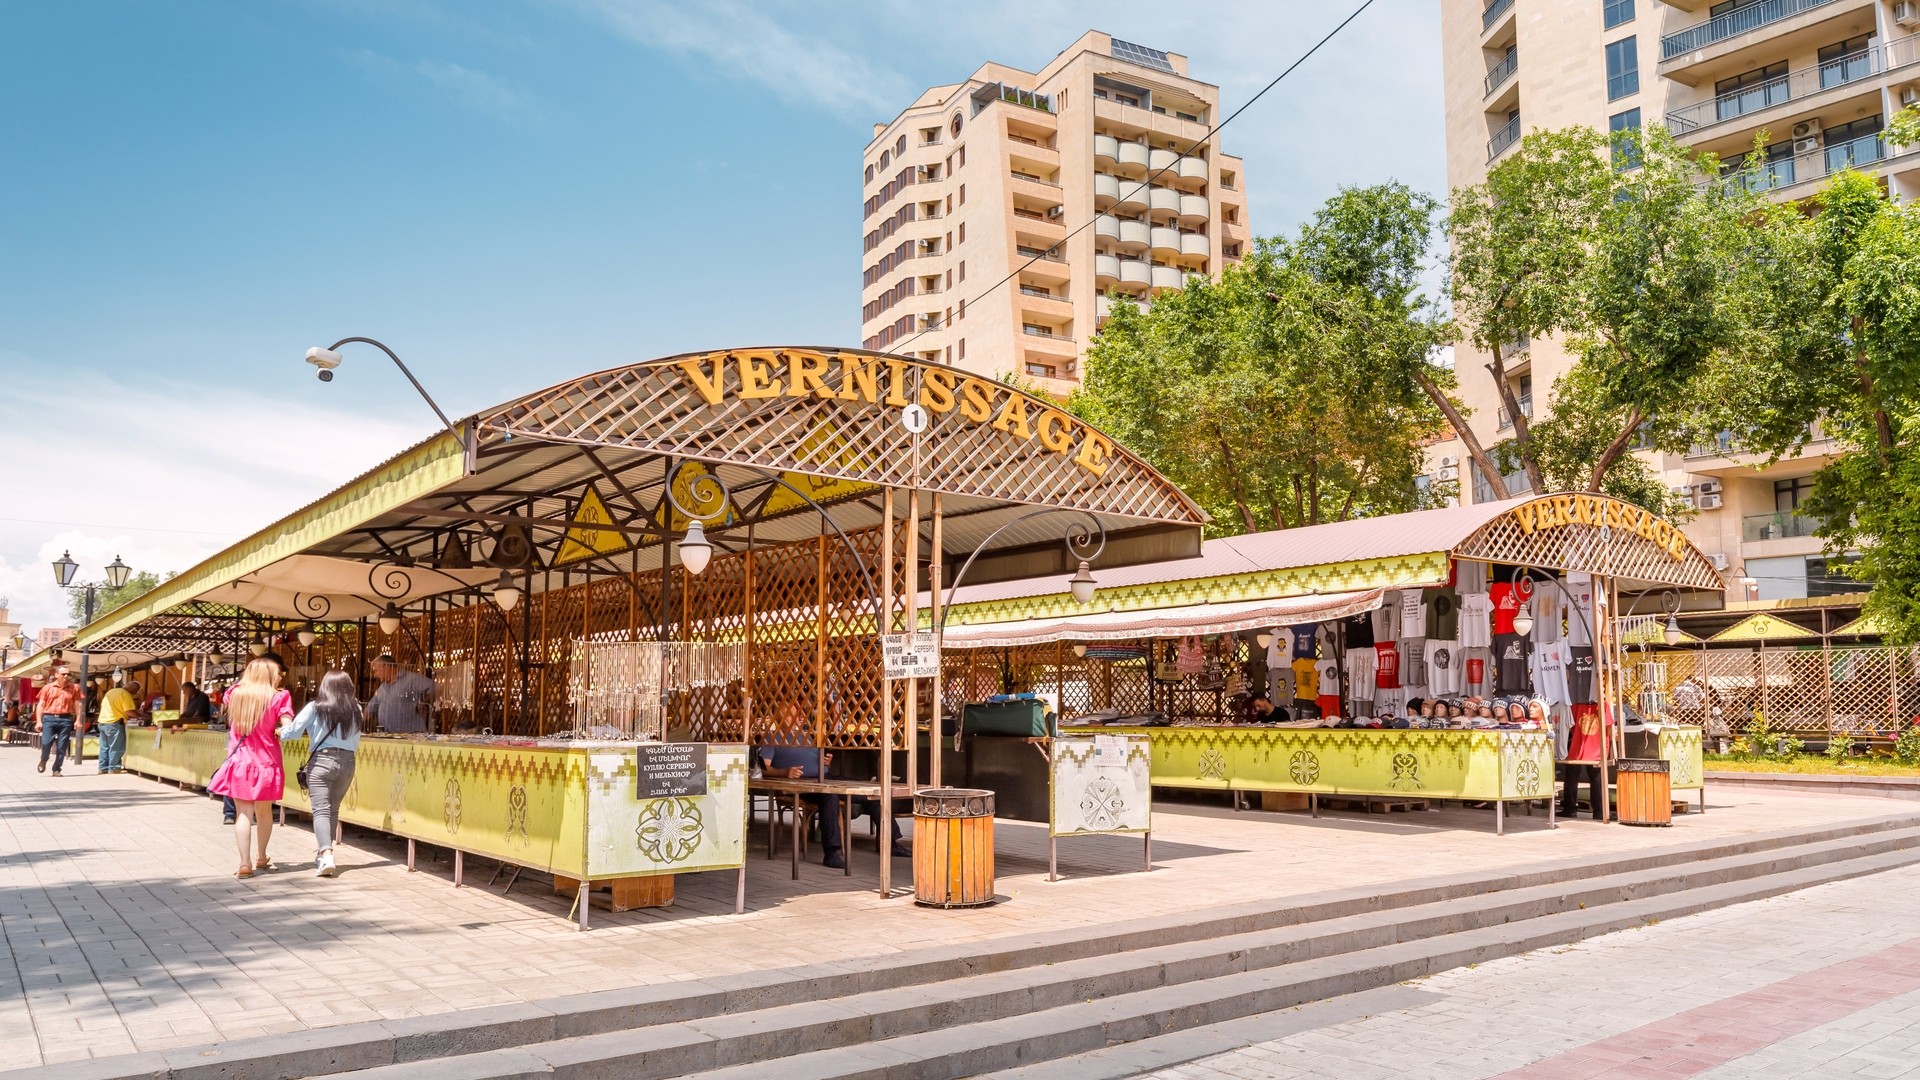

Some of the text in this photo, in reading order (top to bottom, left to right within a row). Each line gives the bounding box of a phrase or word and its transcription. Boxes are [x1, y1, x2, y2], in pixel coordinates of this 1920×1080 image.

[678, 349, 1114, 477] VERNISSAGE
[911, 409, 919, 427] 1
[1514, 493, 1687, 562] VERNISSAGE
[1603, 527, 1608, 540] 2
[914, 644, 935, 653] СЕРЕБРО
[655, 771, 691, 779] МЕЛЬХИОР
